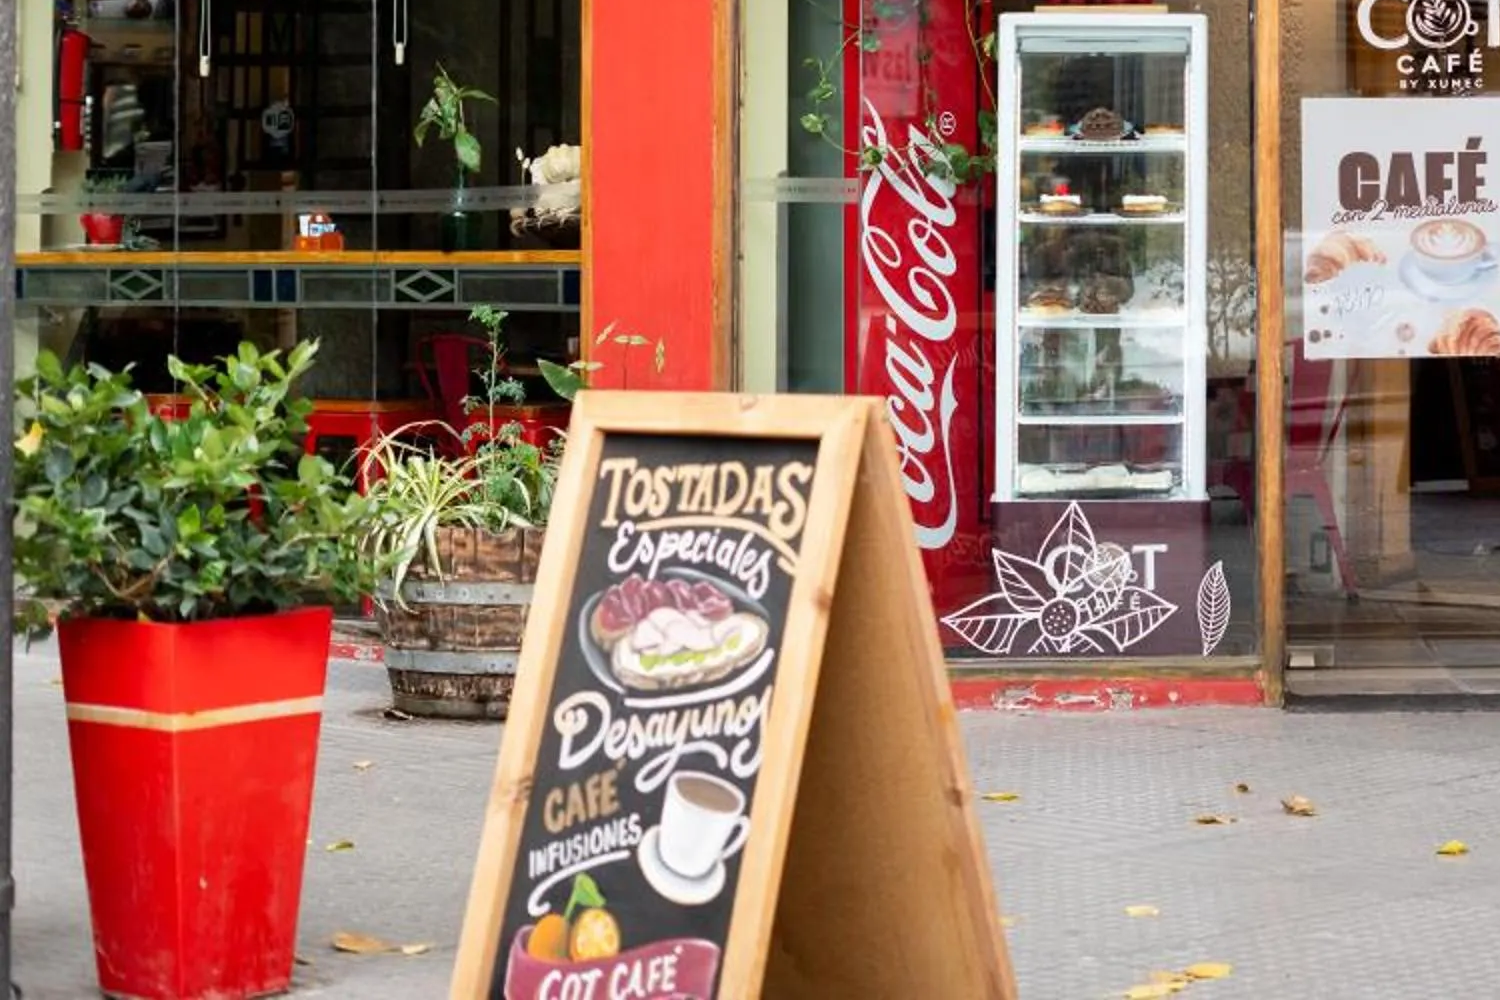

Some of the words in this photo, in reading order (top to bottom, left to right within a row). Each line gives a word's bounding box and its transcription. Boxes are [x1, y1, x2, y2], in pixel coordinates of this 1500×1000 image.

[1396, 48, 1484, 74] CAFÉ
[1400, 79, 1417, 89] BY
[1429, 79, 1484, 89] XUMEC
[1339, 136, 1488, 212] CAFÉ
[1332, 210, 1365, 225] con
[1371, 200, 1388, 221] 2
[1393, 195, 1499, 219] medialunas
[601, 457, 812, 538] TOSTADAS
[608, 522, 774, 600] Especiales
[554, 685, 774, 793] Desayunos
[529, 813, 643, 879] INFUSIONES
[538, 968, 604, 1000] COT
